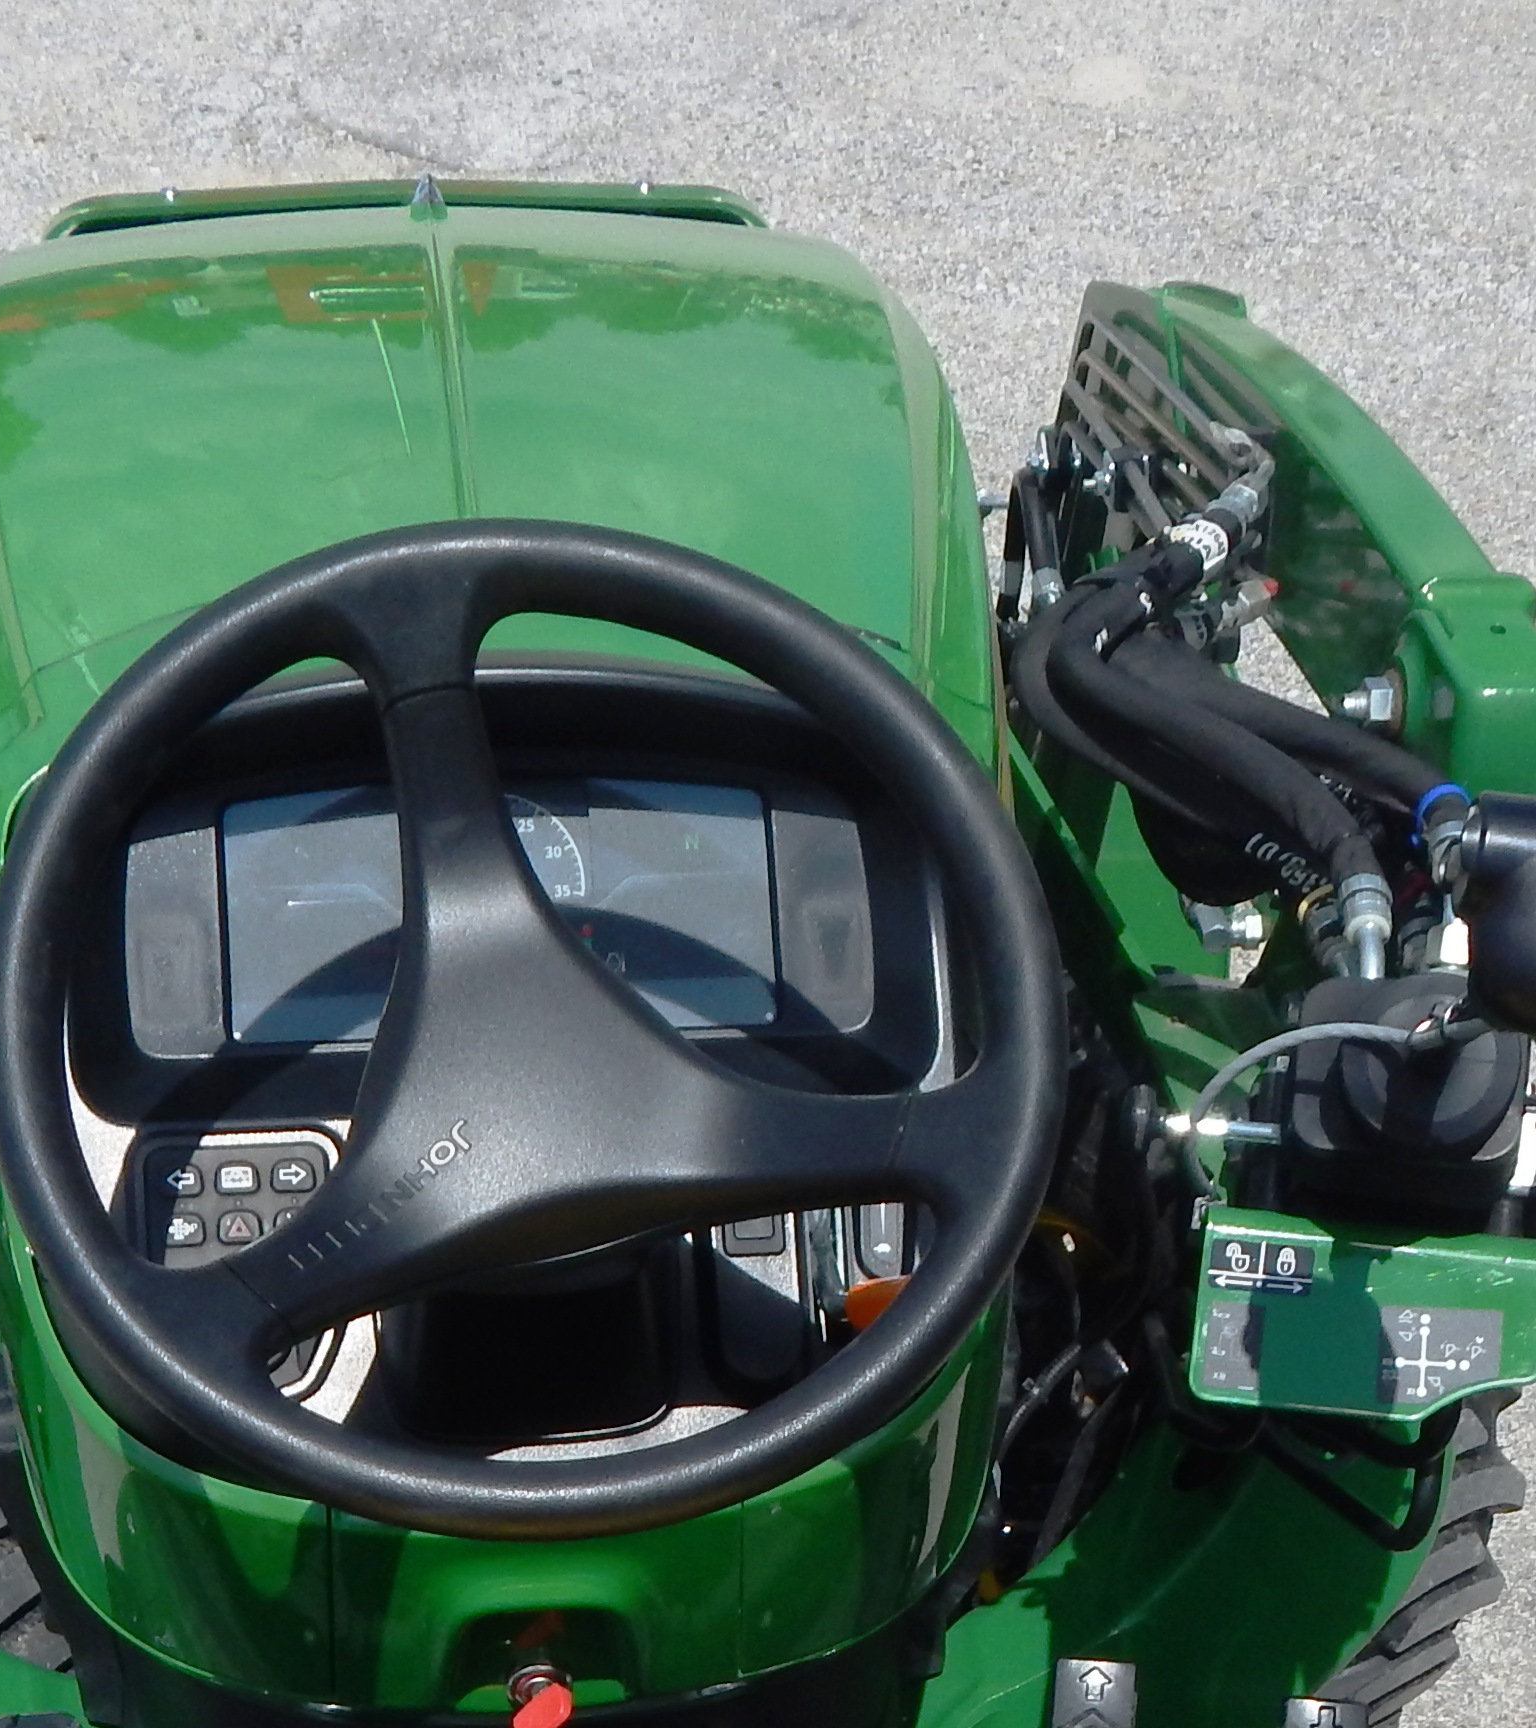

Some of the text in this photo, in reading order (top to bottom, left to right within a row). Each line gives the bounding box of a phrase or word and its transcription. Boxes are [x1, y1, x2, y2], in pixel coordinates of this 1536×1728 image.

[517, 819, 535, 833] 25
[685, 834, 699, 850] N
[545, 846, 562, 859] 30
[554, 884, 571, 898] 35
